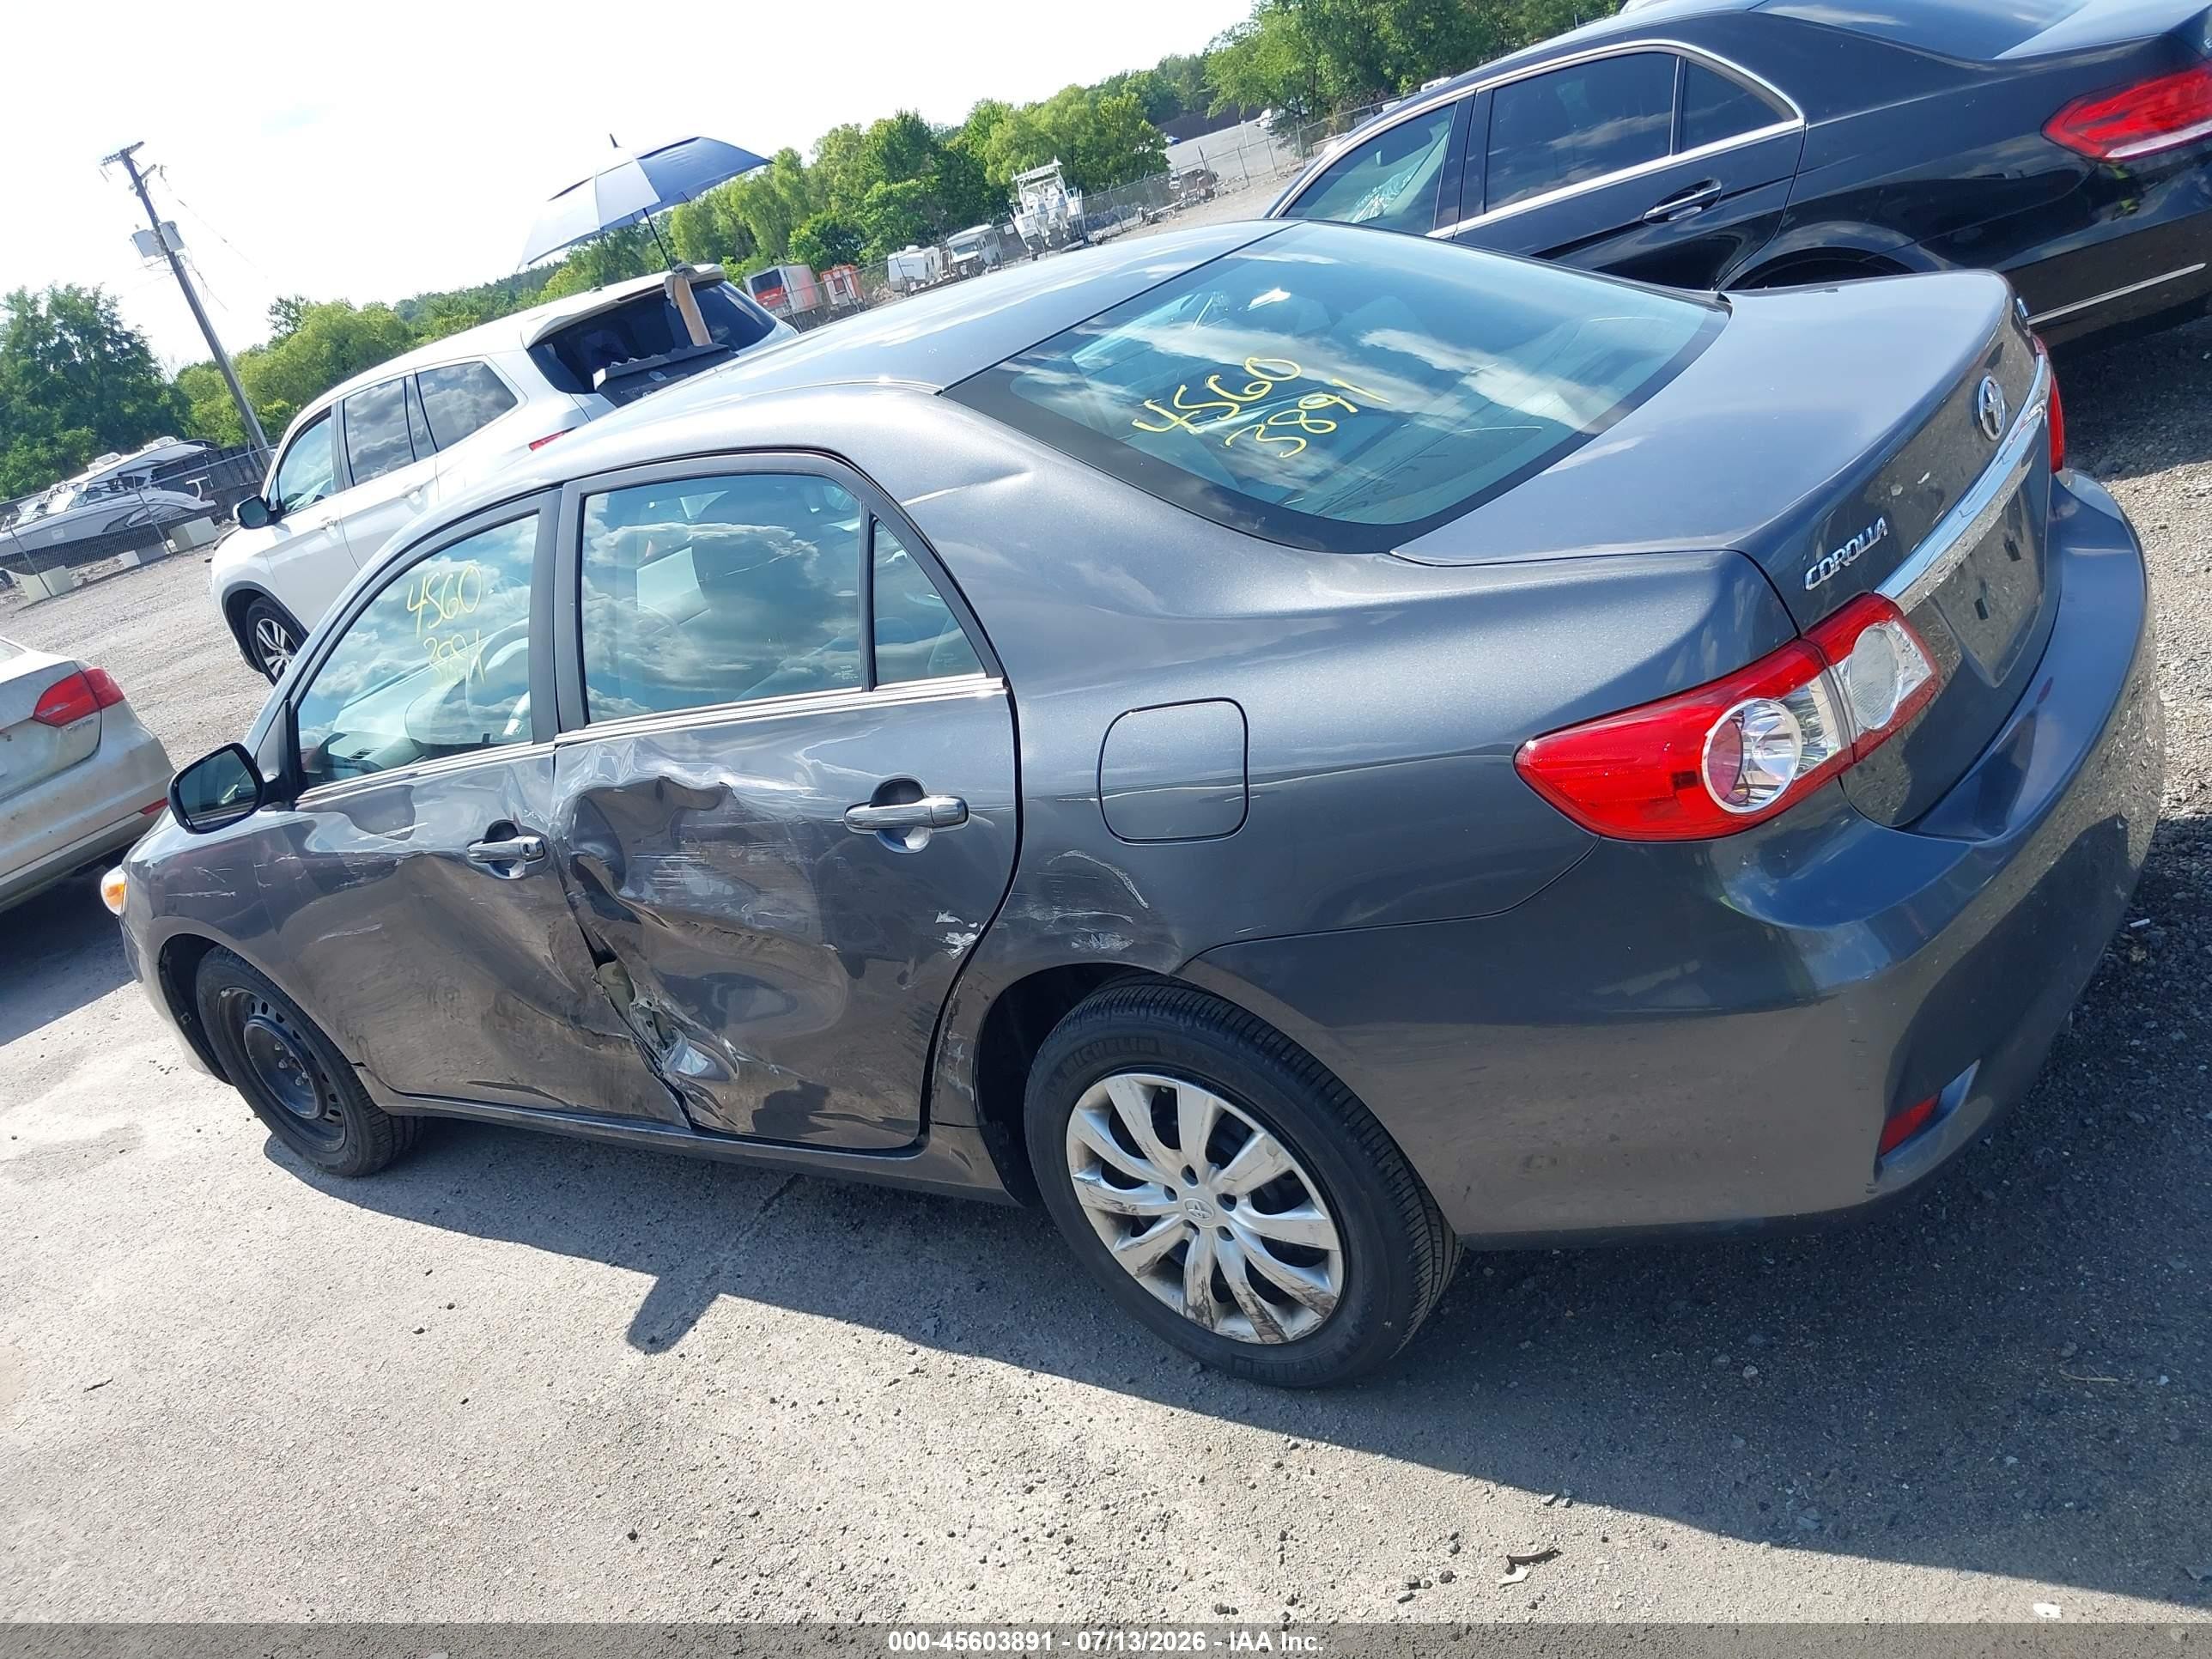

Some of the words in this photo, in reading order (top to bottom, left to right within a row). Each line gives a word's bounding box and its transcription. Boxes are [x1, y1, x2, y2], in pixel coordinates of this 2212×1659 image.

[1131, 356, 1302, 434] 4560
[1224, 378, 1392, 459] 3891
[1806, 517, 1888, 591] COROLLA
[406, 564, 483, 639] 4560
